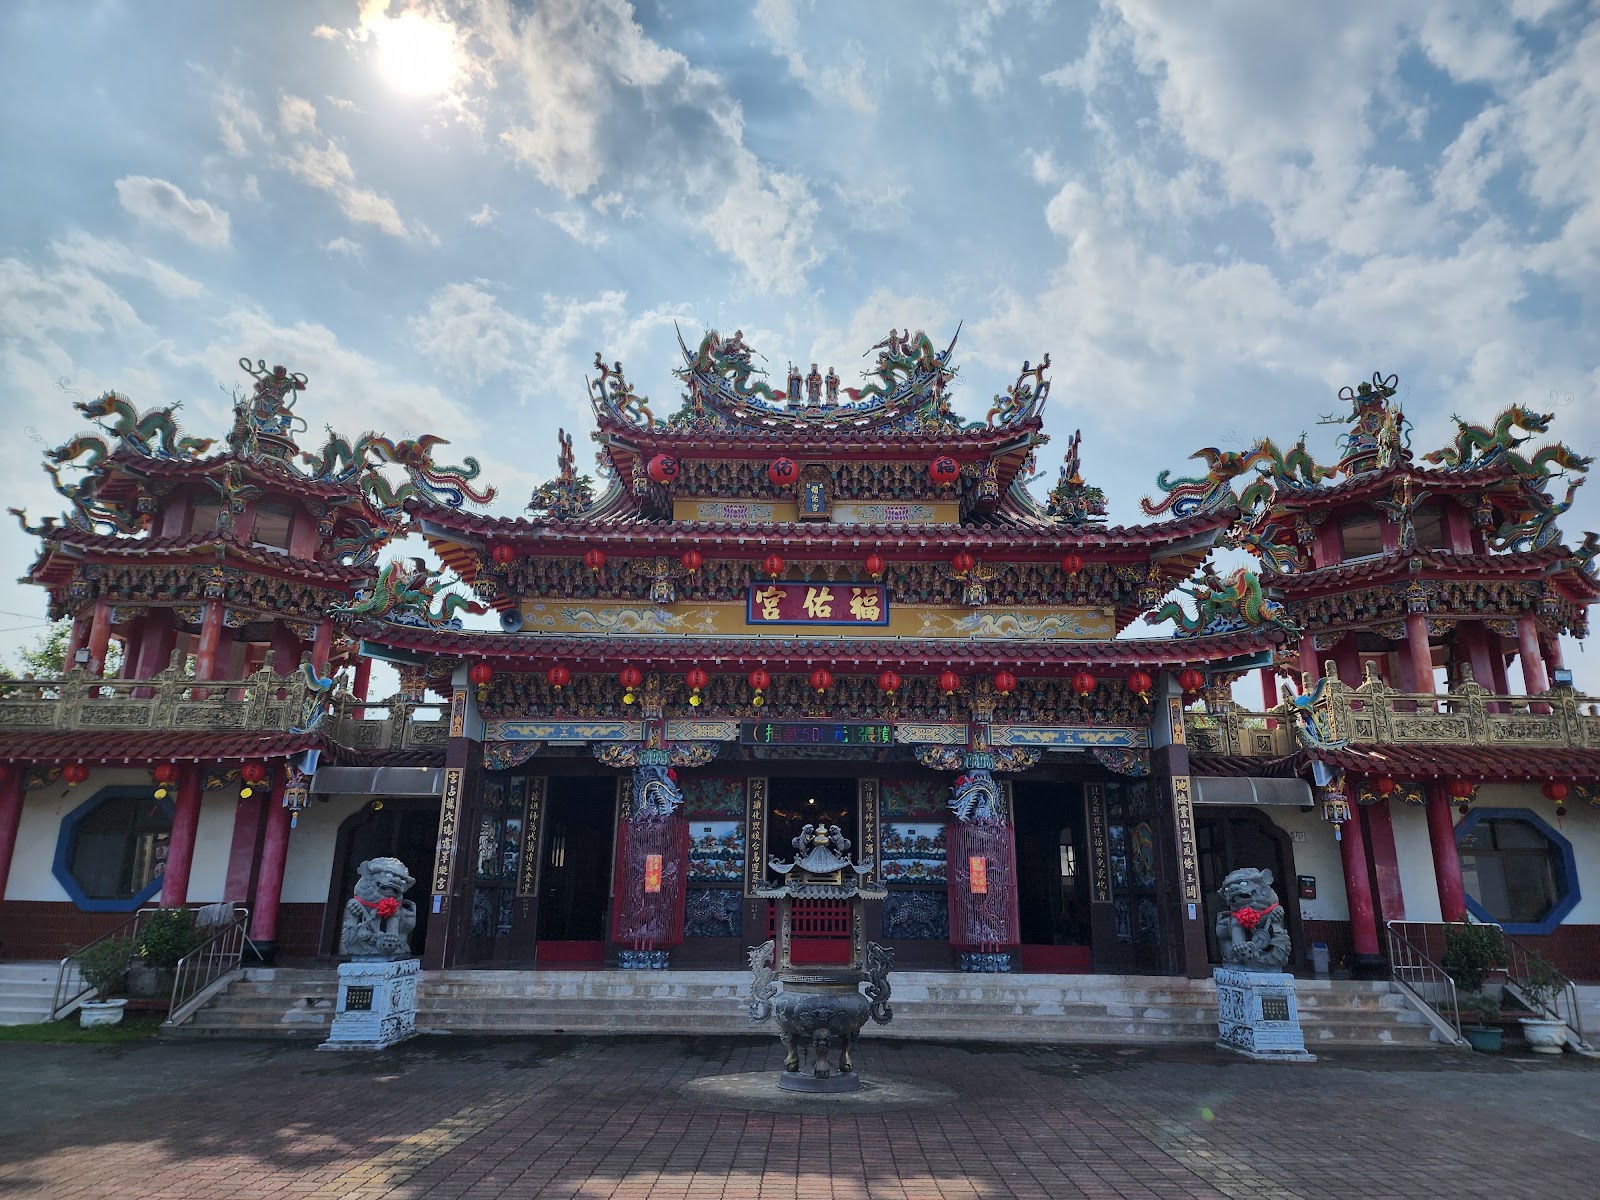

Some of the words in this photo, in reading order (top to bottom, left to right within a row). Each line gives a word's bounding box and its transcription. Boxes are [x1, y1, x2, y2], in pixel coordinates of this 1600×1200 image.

[660, 457, 676, 475] 宮
[772, 460, 792, 476] 佑
[936, 458, 956, 474] 福
[811, 486, 819, 512] 福佑宮
[755, 585, 881, 621] 福佑宮
